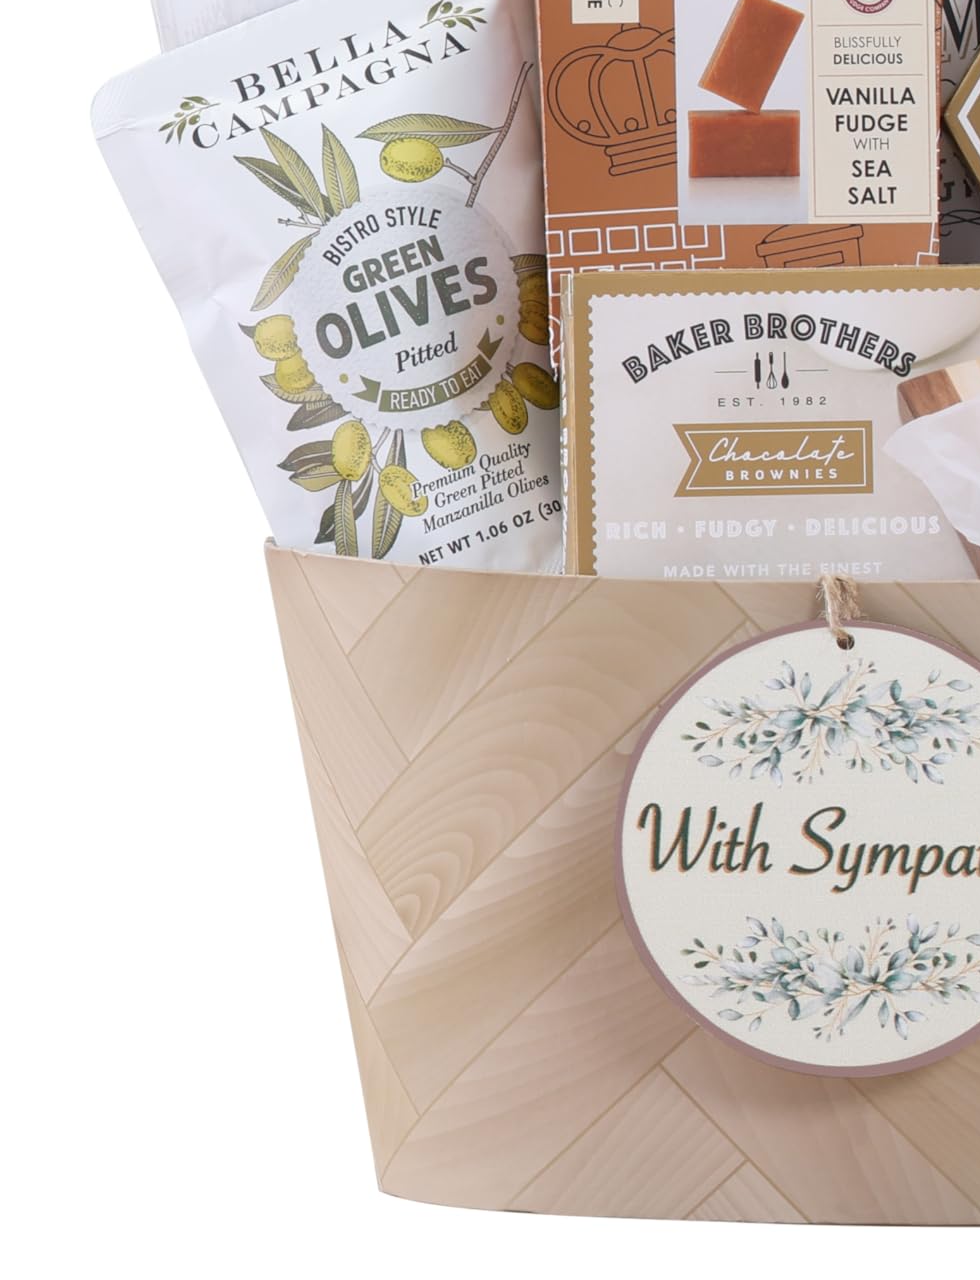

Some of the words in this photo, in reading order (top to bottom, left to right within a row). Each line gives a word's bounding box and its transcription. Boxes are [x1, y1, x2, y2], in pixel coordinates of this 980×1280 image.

[230, 20, 411, 103] BELLA
[833, 53, 903, 65] DELICIOUS
[834, 36, 902, 49] BLISSFULLY
[192, 31, 470, 149] CAMPAGNA
[826, 87, 916, 105] VANILLA
[835, 114, 908, 133] FUDGE
[853, 137, 890, 151] WITH
[851, 160, 892, 178] SEA
[848, 186, 897, 205] SALT
[322, 214, 380, 267] BISTRO
[385, 206, 442, 229] STYLE
[343, 234, 445, 293] GREEN
[316, 256, 498, 359] OLIVES
[395, 330, 458, 374] Pitted
[621, 319, 734, 383] BAKER
[743, 313, 917, 377] BROTHERS
[390, 386, 435, 410] READY
[439, 377, 460, 397] TO
[461, 362, 483, 386] EAT
[717, 397, 764, 407] EST.
[780, 396, 828, 407] 1982
[411, 464, 476, 499] Premium
[479, 443, 532, 470] Quality
[708, 435, 854, 466] Chocolate
[434, 483, 477, 509] Green
[480, 460, 525, 490] Pitted
[726, 468, 838, 481] BROWNIES
[422, 491, 504, 534] Manzanilla
[507, 475, 550, 498] Olives
[418, 545, 445, 565] NET
[446, 535, 472, 555] WT
[475, 521, 508, 543] 1.06
[512, 510, 535, 528] OZ
[605, 521, 667, 540] RICH
[695, 519, 777, 539] FUDGY
[805, 515, 941, 536] DELICIOUS
[664, 565, 715, 578] MADE
[723, 563, 769, 577] WITH
[776, 563, 812, 576] THE
[636, 801, 773, 875] With
